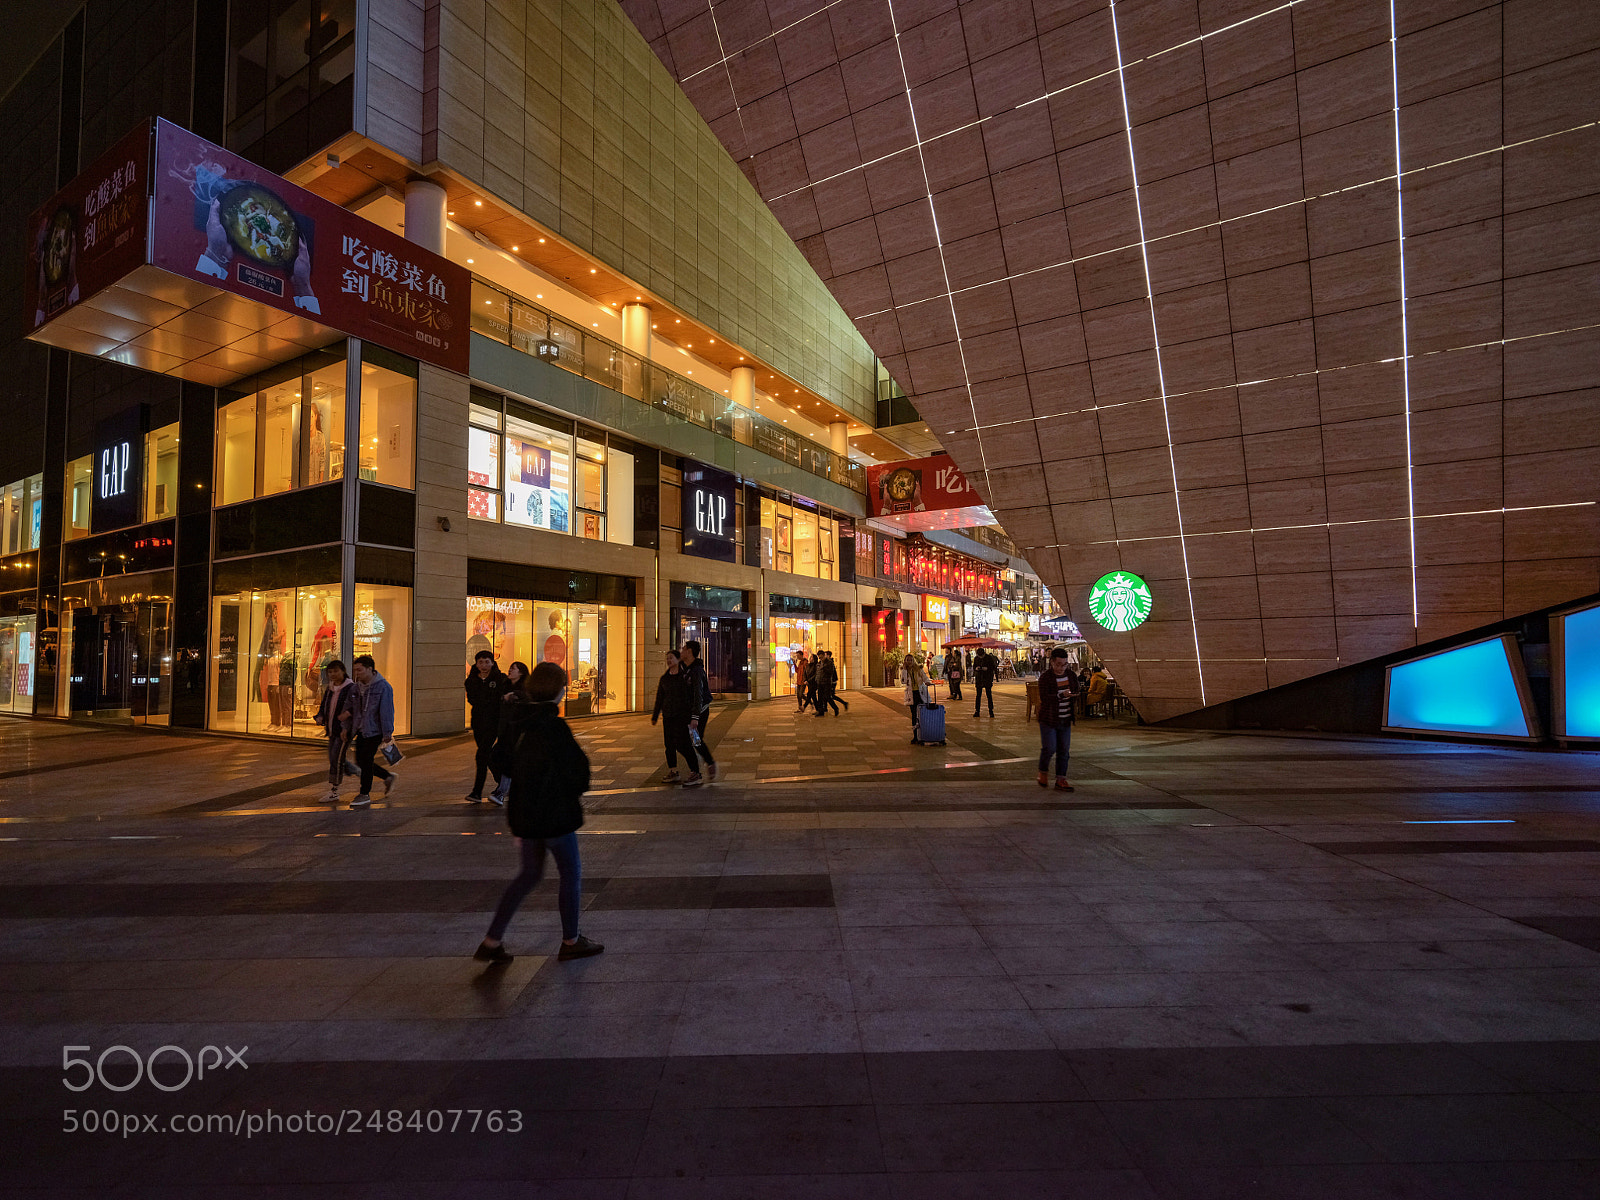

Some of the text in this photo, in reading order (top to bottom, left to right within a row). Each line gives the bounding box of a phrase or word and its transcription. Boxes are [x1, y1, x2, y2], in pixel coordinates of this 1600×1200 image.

[342, 234, 449, 305] 吃酸菜鱼
[488, 319, 509, 334] SPEED
[101, 441, 130, 499] GAP
[526, 454, 547, 477] GAP
[695, 489, 727, 536] GAP
